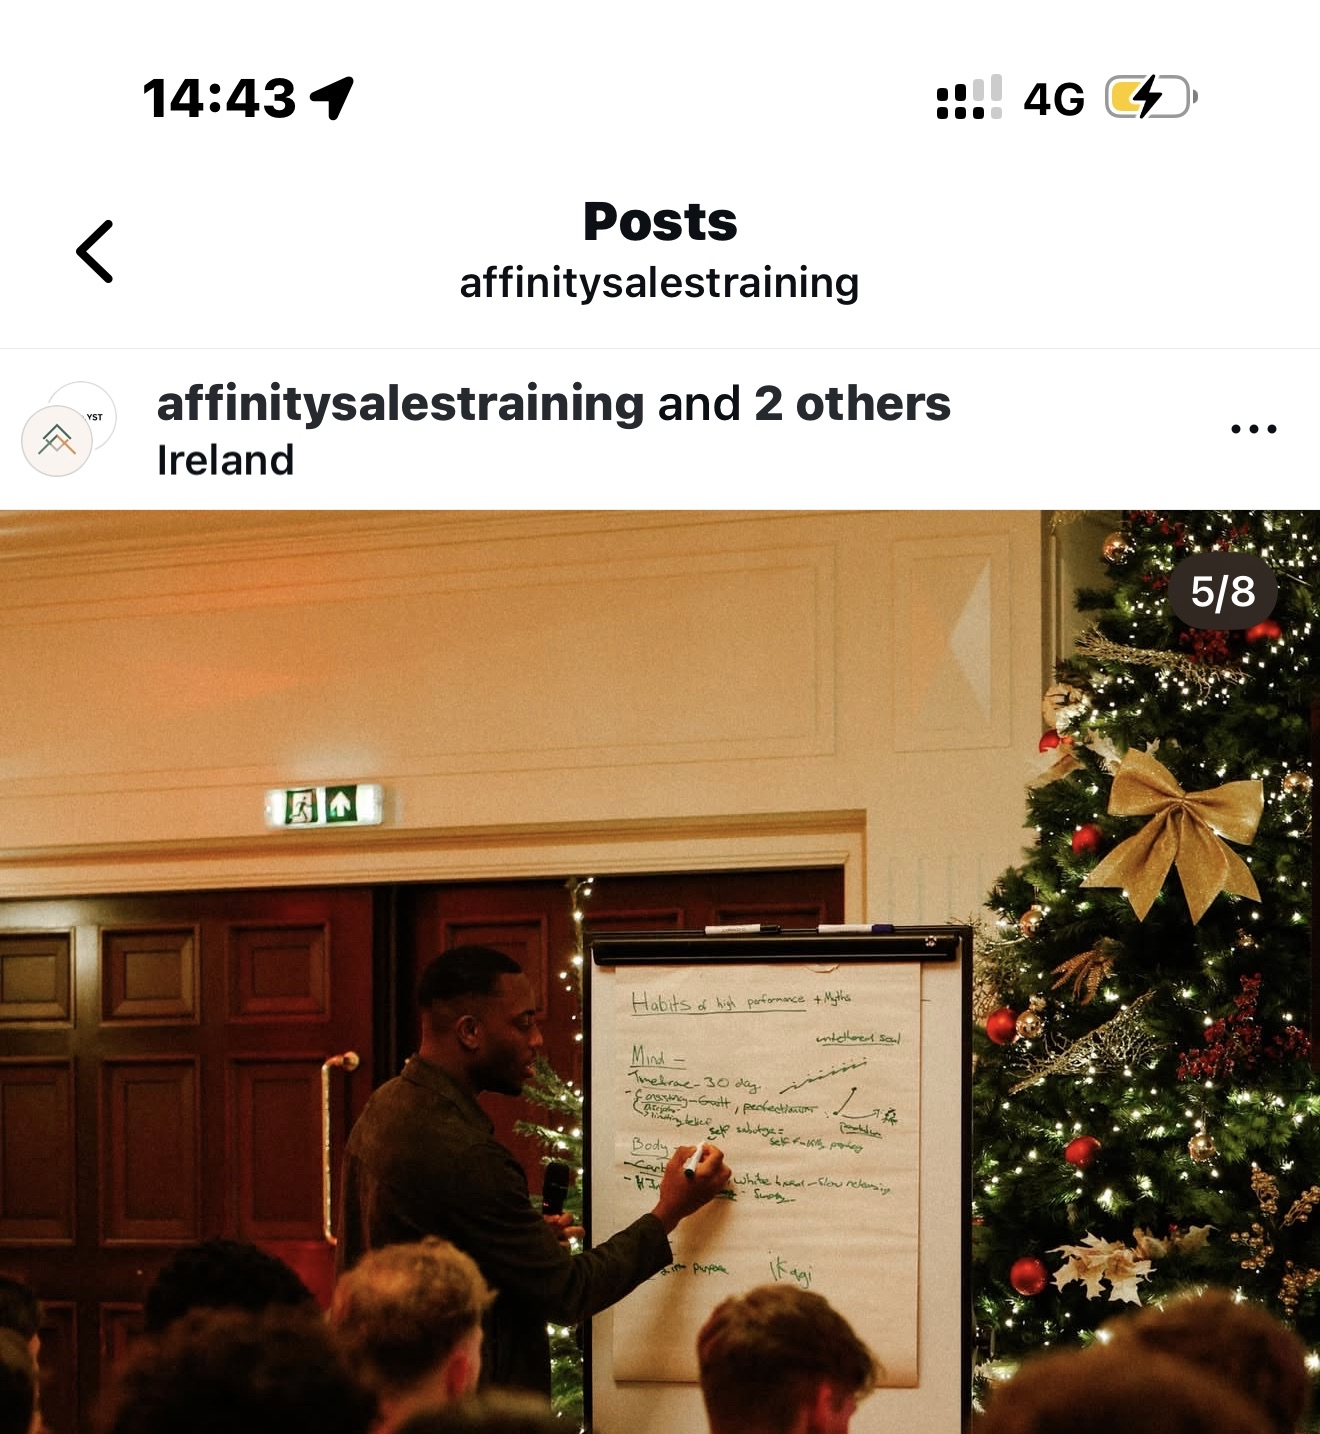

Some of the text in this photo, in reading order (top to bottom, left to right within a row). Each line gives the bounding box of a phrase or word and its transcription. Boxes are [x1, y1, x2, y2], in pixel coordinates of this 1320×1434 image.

[144, 78, 295, 118] 14:43
[1024, 82, 1084, 116] 4G
[585, 202, 737, 241] Posts
[461, 265, 857, 305] affinitysalestraining
[84, 413, 103, 421] YST
[158, 382, 950, 429] affinitysalestraining and 2 others
[160, 443, 293, 475] Ireland
[631, 991, 692, 1013] Habits
[717, 997, 736, 1010] high
[747, 992, 806, 1008] performance
[631, 1045, 665, 1065] Mind
[704, 1077, 730, 1088] 30
[633, 1137, 668, 1158] Body
